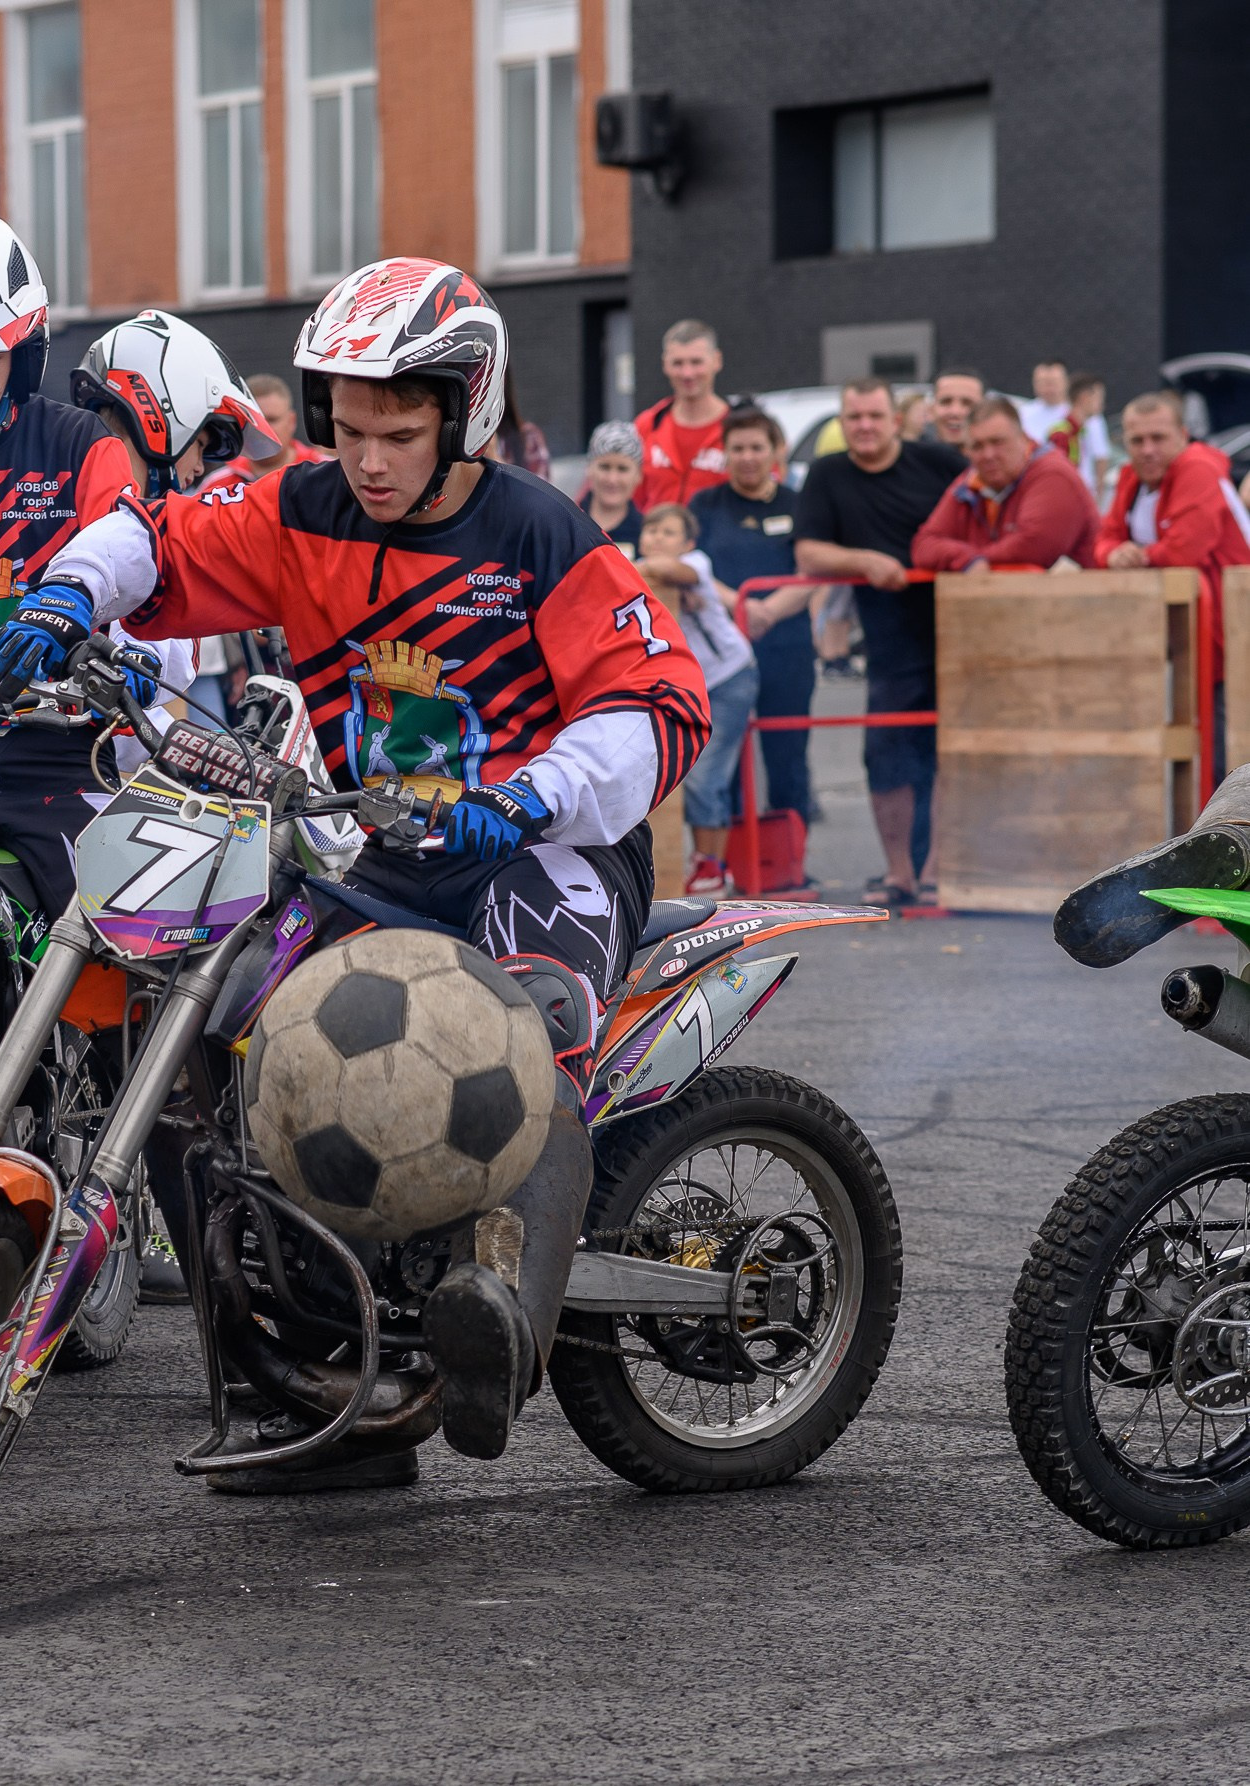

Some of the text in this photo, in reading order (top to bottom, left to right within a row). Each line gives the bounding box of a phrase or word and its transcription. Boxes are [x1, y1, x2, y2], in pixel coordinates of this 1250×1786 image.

[126, 373, 165, 434] MOTS
[15, 481, 59, 493] КОВОВ
[466, 572, 521, 589] КОВРОВ
[471, 591, 513, 604] город
[19, 610, 73, 633] EXPERT
[435, 603, 527, 620] воинской сла
[612, 592, 671, 658] 7
[126, 787, 180, 808] КОВРОВЕЦ
[469, 786, 522, 818] EXPERT
[101, 815, 224, 917] 7
[673, 918, 763, 956] DUNLOP
[701, 1015, 750, 1070] КОВРОВЕЦ
